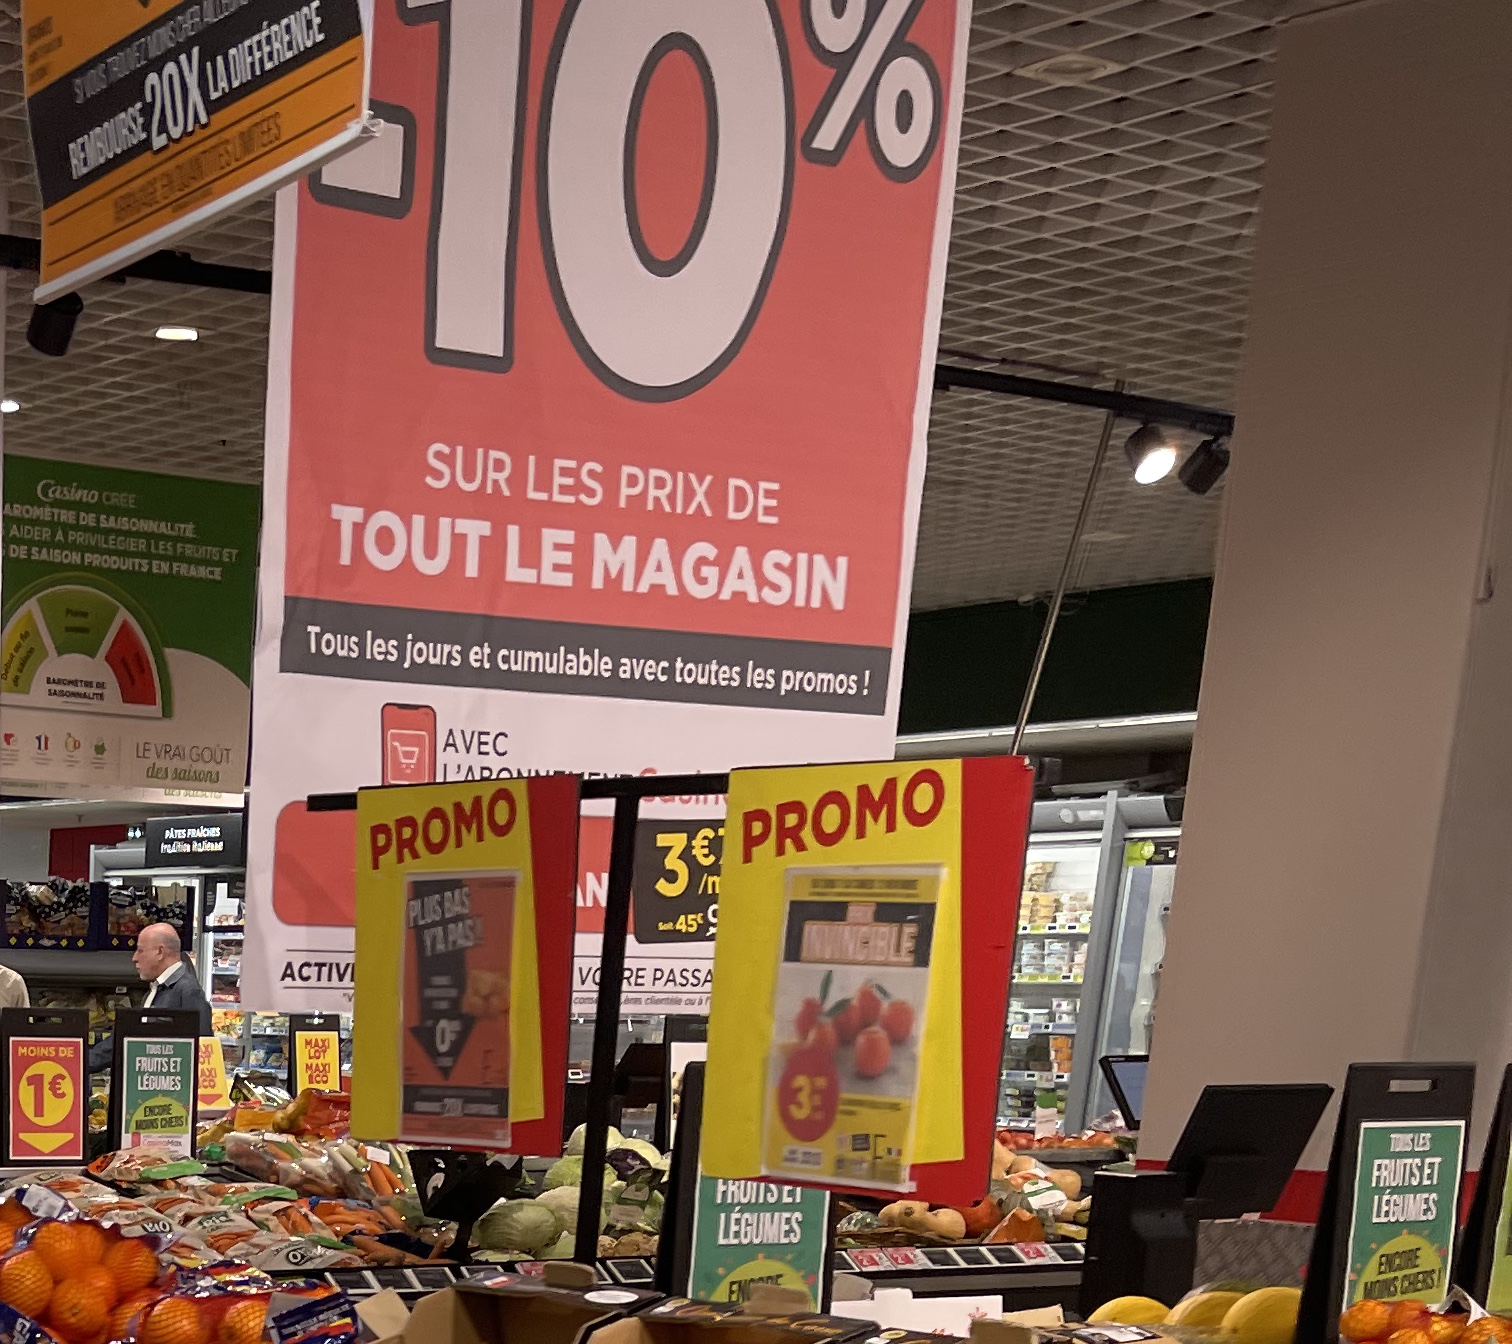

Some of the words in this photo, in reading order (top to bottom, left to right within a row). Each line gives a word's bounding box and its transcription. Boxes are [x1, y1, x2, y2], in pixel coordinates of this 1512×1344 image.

[144, 46, 209, 150] 20X
[205, 54, 229, 100] LA
[227, 0, 326, 91] DIFFÉRENCE
[36, 479, 99, 503] Casino
[425, 443, 511, 496] SUR
[526, 454, 604, 507] LES
[619, 463, 713, 518] PRIX
[727, 478, 780, 525] DE
[3, 503, 76, 524] AROMÈTRE
[79, 512, 97, 526] DE
[9, 524, 52, 542] AIDER
[55, 526, 65, 543] À
[150, 540, 173, 556] LES
[176, 543, 220, 560] FRUITS
[222, 549, 240, 562] ET
[331, 503, 491, 578] TOUT
[505, 524, 576, 587] LE
[590, 531, 849, 610] MAGASIN
[9, 545, 28, 558] DE
[31, 546, 81, 565] SAISON
[84, 552, 150, 573] PRODUITS
[151, 560, 170, 574] EN
[172, 562, 223, 580] FRANCE
[307, 625, 359, 659] Tous
[365, 629, 399, 662] les
[403, 633, 462, 670] jours
[468, 641, 491, 669] et
[497, 644, 613, 679] cumulable
[618, 655, 669, 682] avec
[674, 661, 742, 688] toutes
[746, 662, 776, 690] les
[136, 742, 151, 759] LE
[154, 743, 186, 761] VRAI
[443, 728, 509, 757] AVEC
[146, 762, 169, 780] des
[171, 764, 220, 784] saisons
[370, 787, 517, 870] PROMO
[741, 768, 946, 864] PROMO
[444, 886, 470, 917] BAS
[280, 962, 355, 983] ACTIV
[652, 969, 714, 988] PASSA
[18, 1046, 55, 1057] MOINS
[58, 1047, 74, 1057] DE
[305, 1038, 330, 1049] MAXI
[308, 1049, 327, 1059] LOT
[136, 1057, 168, 1072] FRUITS
[170, 1058, 182, 1073] ET
[305, 1063, 330, 1073] MAXI
[26, 1073, 67, 1117] 1€
[138, 1073, 181, 1090] LÉGUMES
[1390, 1133, 1414, 1152] TOUS
[1414, 1133, 1432, 1151] LES
[1372, 1158, 1421, 1187] FRUITS
[1422, 1157, 1442, 1185] ET
[716, 1179, 780, 1204] FRUITS
[781, 1183, 803, 1203] ET
[1372, 1189, 1438, 1224] LÉGUMES
[718, 1207, 803, 1245] LÉGUMES
[1377, 1247, 1421, 1276] ENCORE
